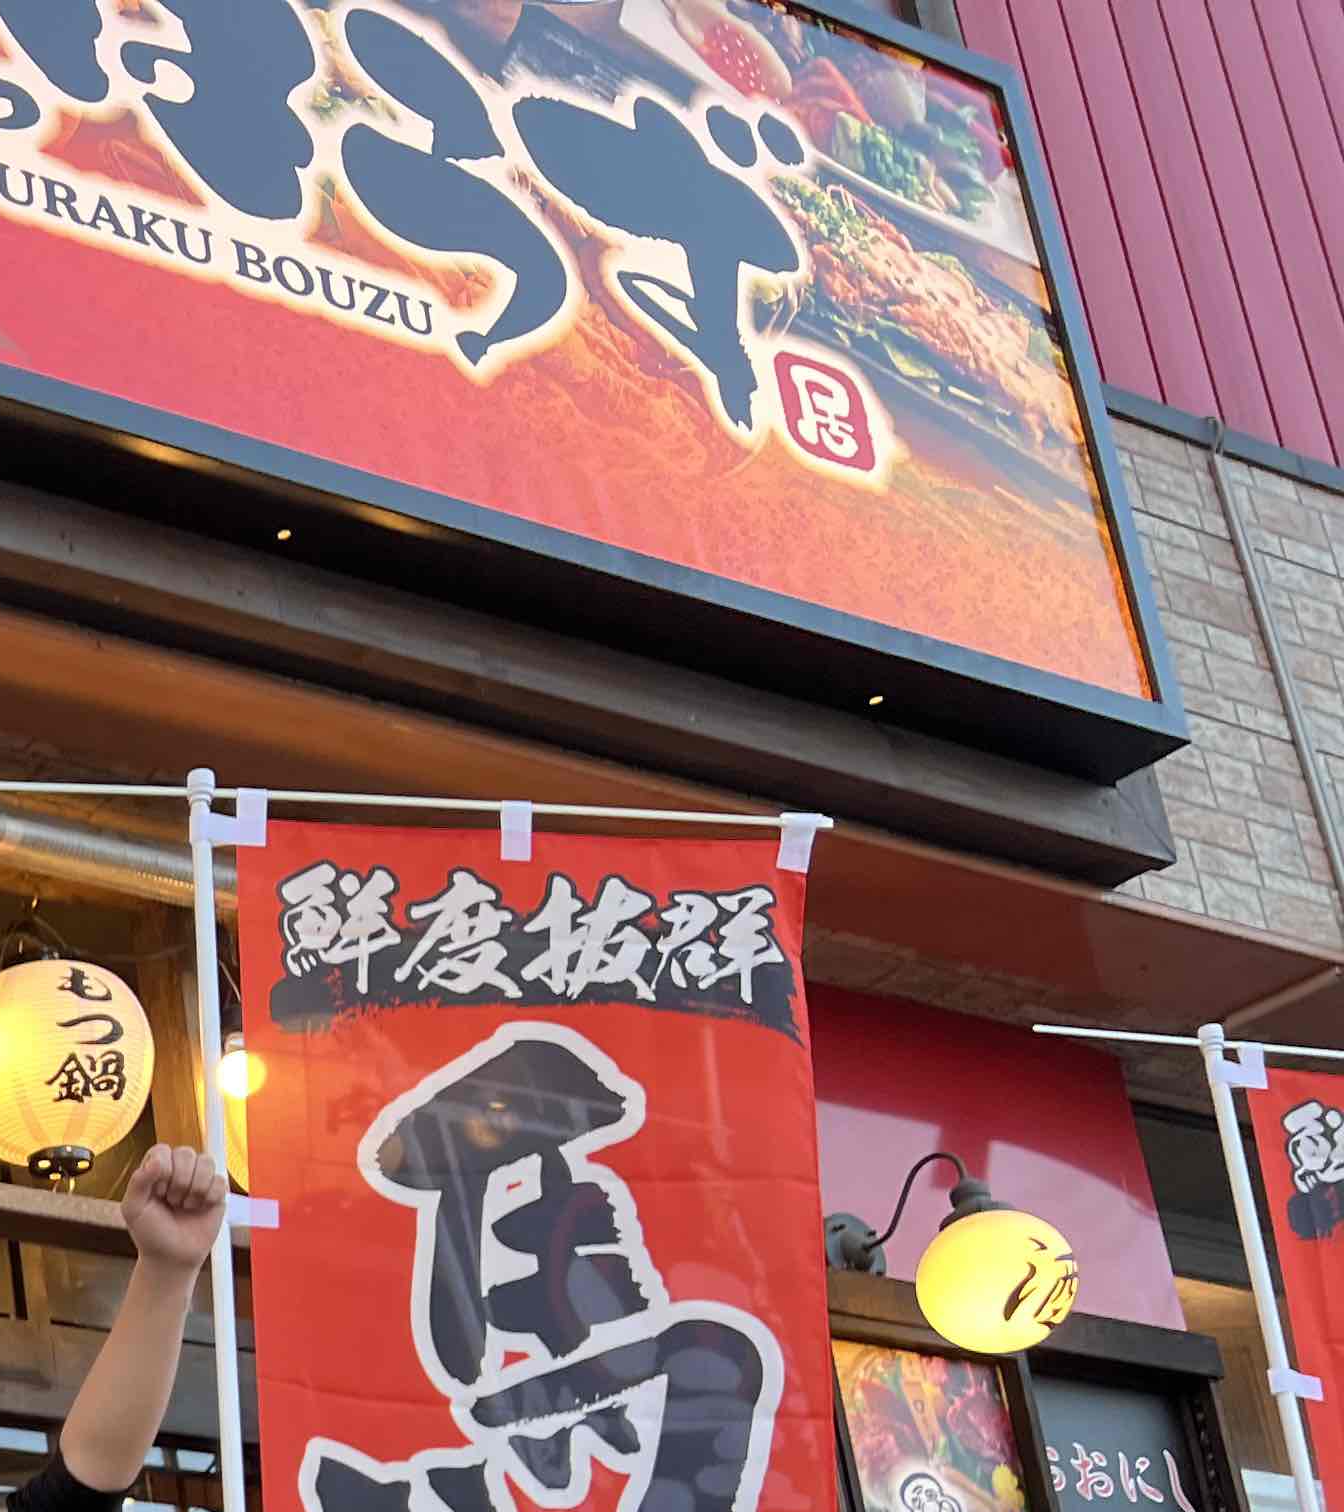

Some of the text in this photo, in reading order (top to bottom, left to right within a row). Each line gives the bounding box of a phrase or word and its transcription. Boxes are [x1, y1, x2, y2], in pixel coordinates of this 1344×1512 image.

[232, 238, 438, 341] BOUZU
[278, 860, 786, 1005] 鮮度抜群
[44, 967, 126, 1104] もつ鍋
